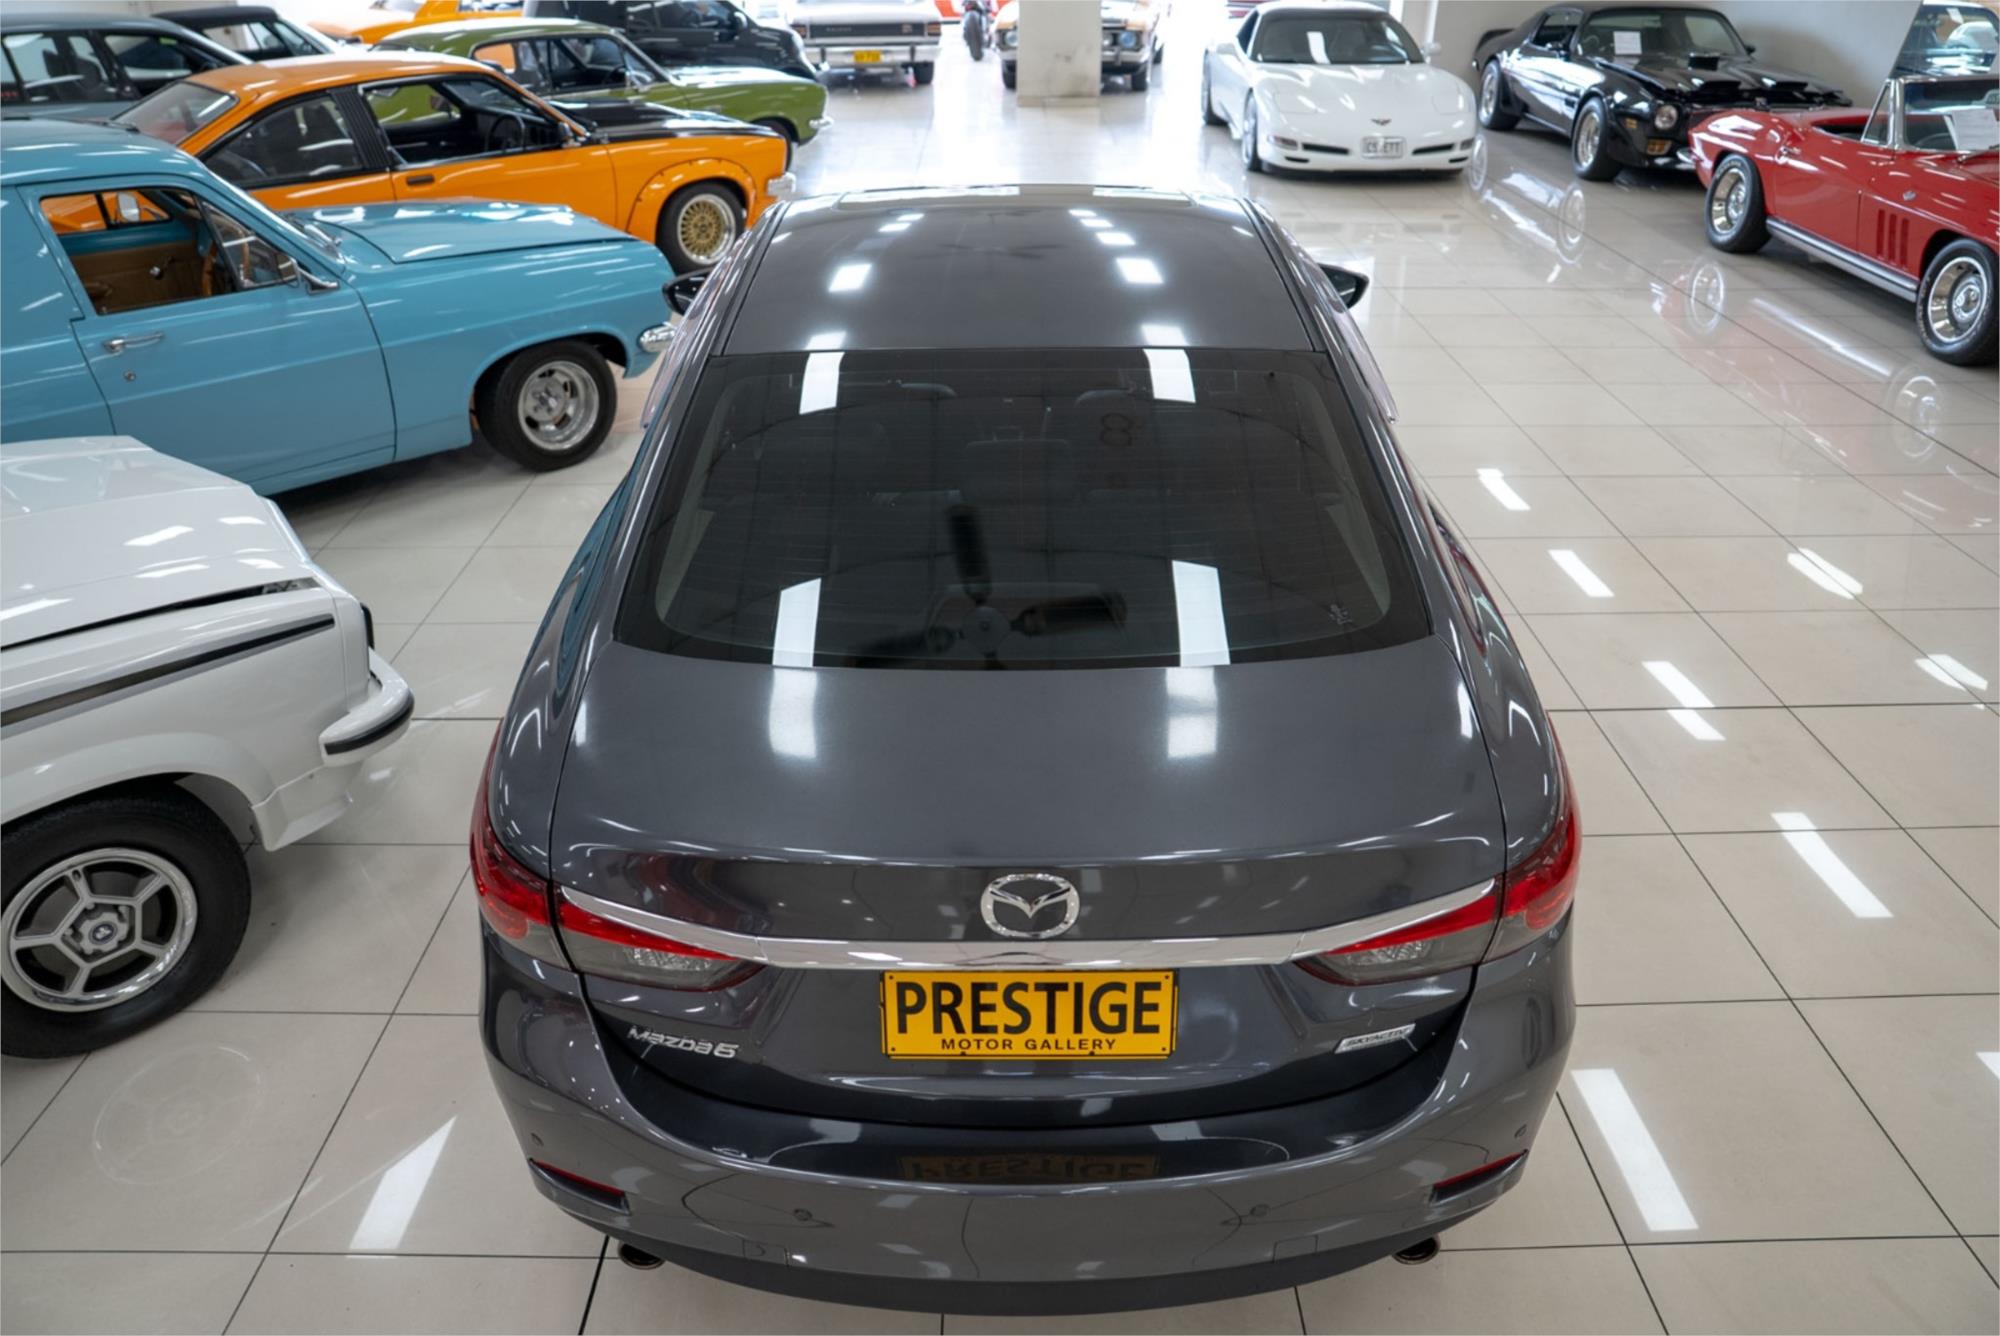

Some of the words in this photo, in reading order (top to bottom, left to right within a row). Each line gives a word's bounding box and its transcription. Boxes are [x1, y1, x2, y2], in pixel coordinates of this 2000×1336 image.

[896, 981, 1162, 1035] PRESTIGE
[941, 1038, 1014, 1050] MOTOR
[1024, 1038, 1117, 1050] GALLERY
